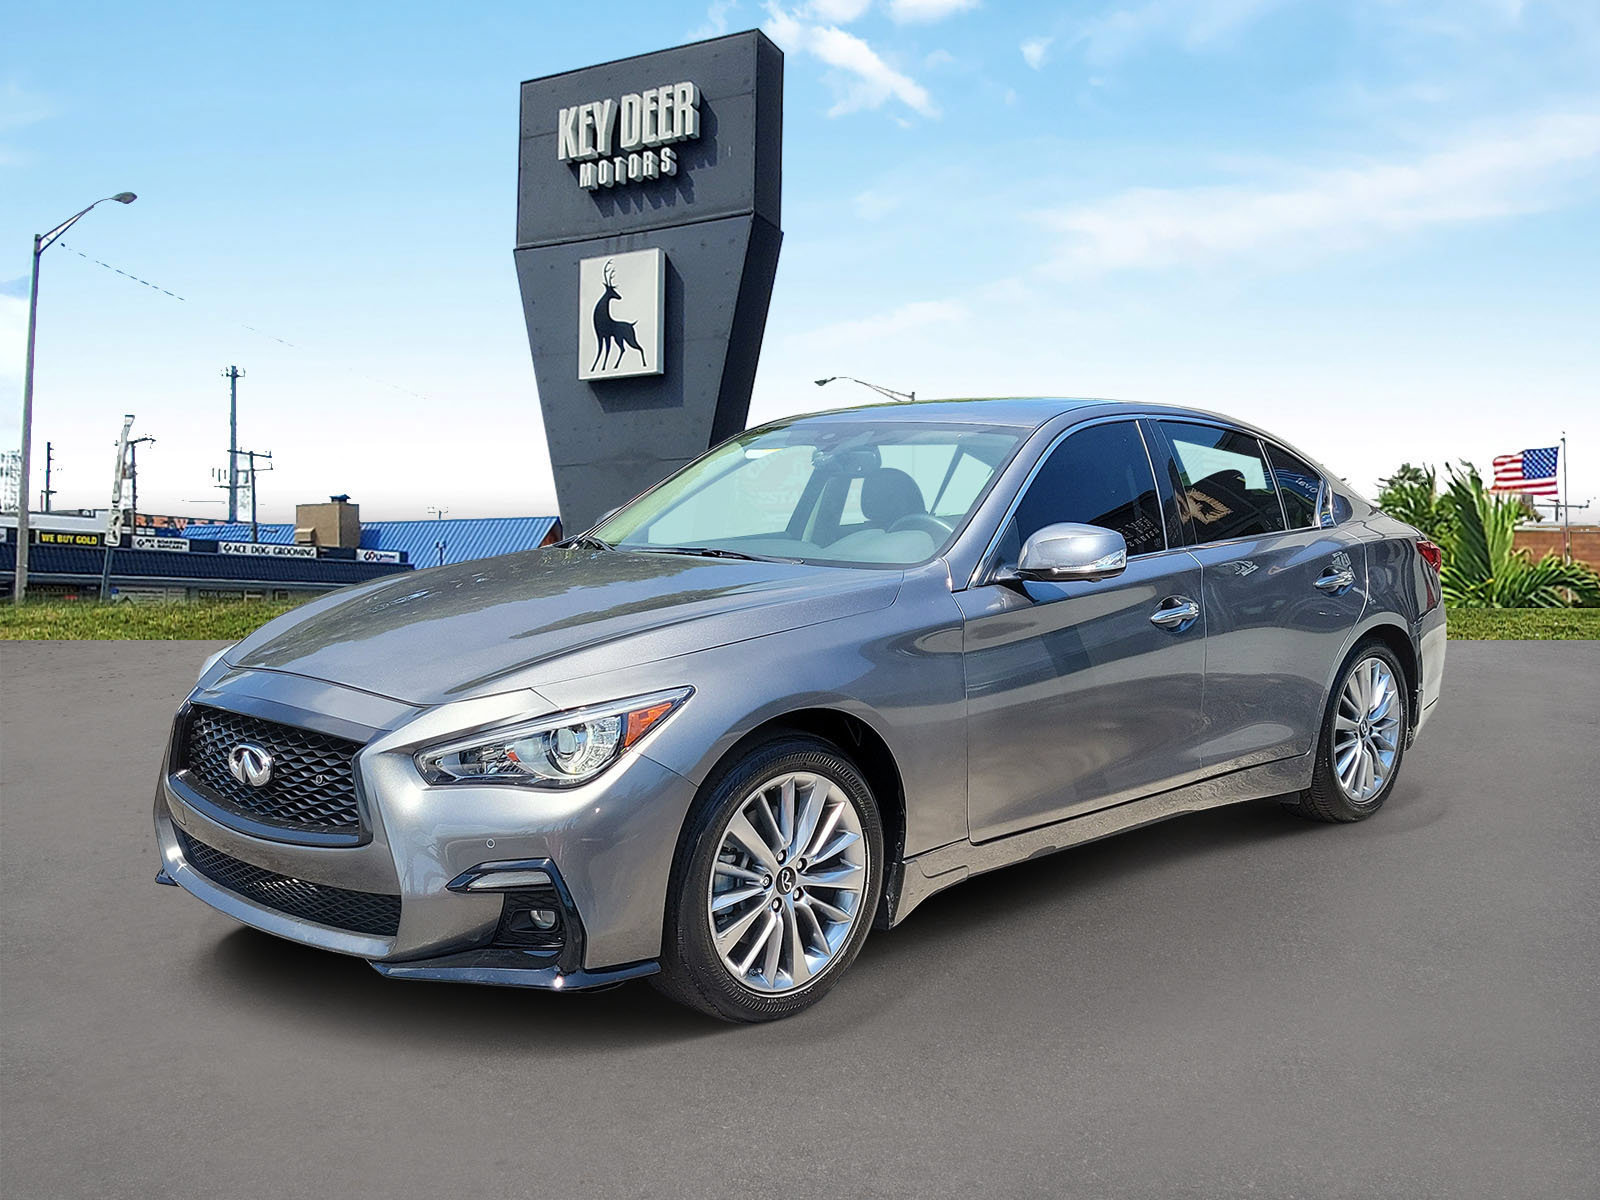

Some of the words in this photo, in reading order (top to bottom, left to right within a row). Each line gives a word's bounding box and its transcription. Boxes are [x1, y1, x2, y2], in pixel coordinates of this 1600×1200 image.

[558, 98, 618, 163] KEY
[620, 81, 700, 151] DEER
[579, 147, 677, 191] MOTORS
[41, 533, 55, 543] WE
[57, 534, 74, 544] BUY
[76, 535, 98, 545] GOLD
[232, 545, 247, 554] ACE
[251, 545, 270, 555] DOG
[273, 546, 315, 557] GROOMING
